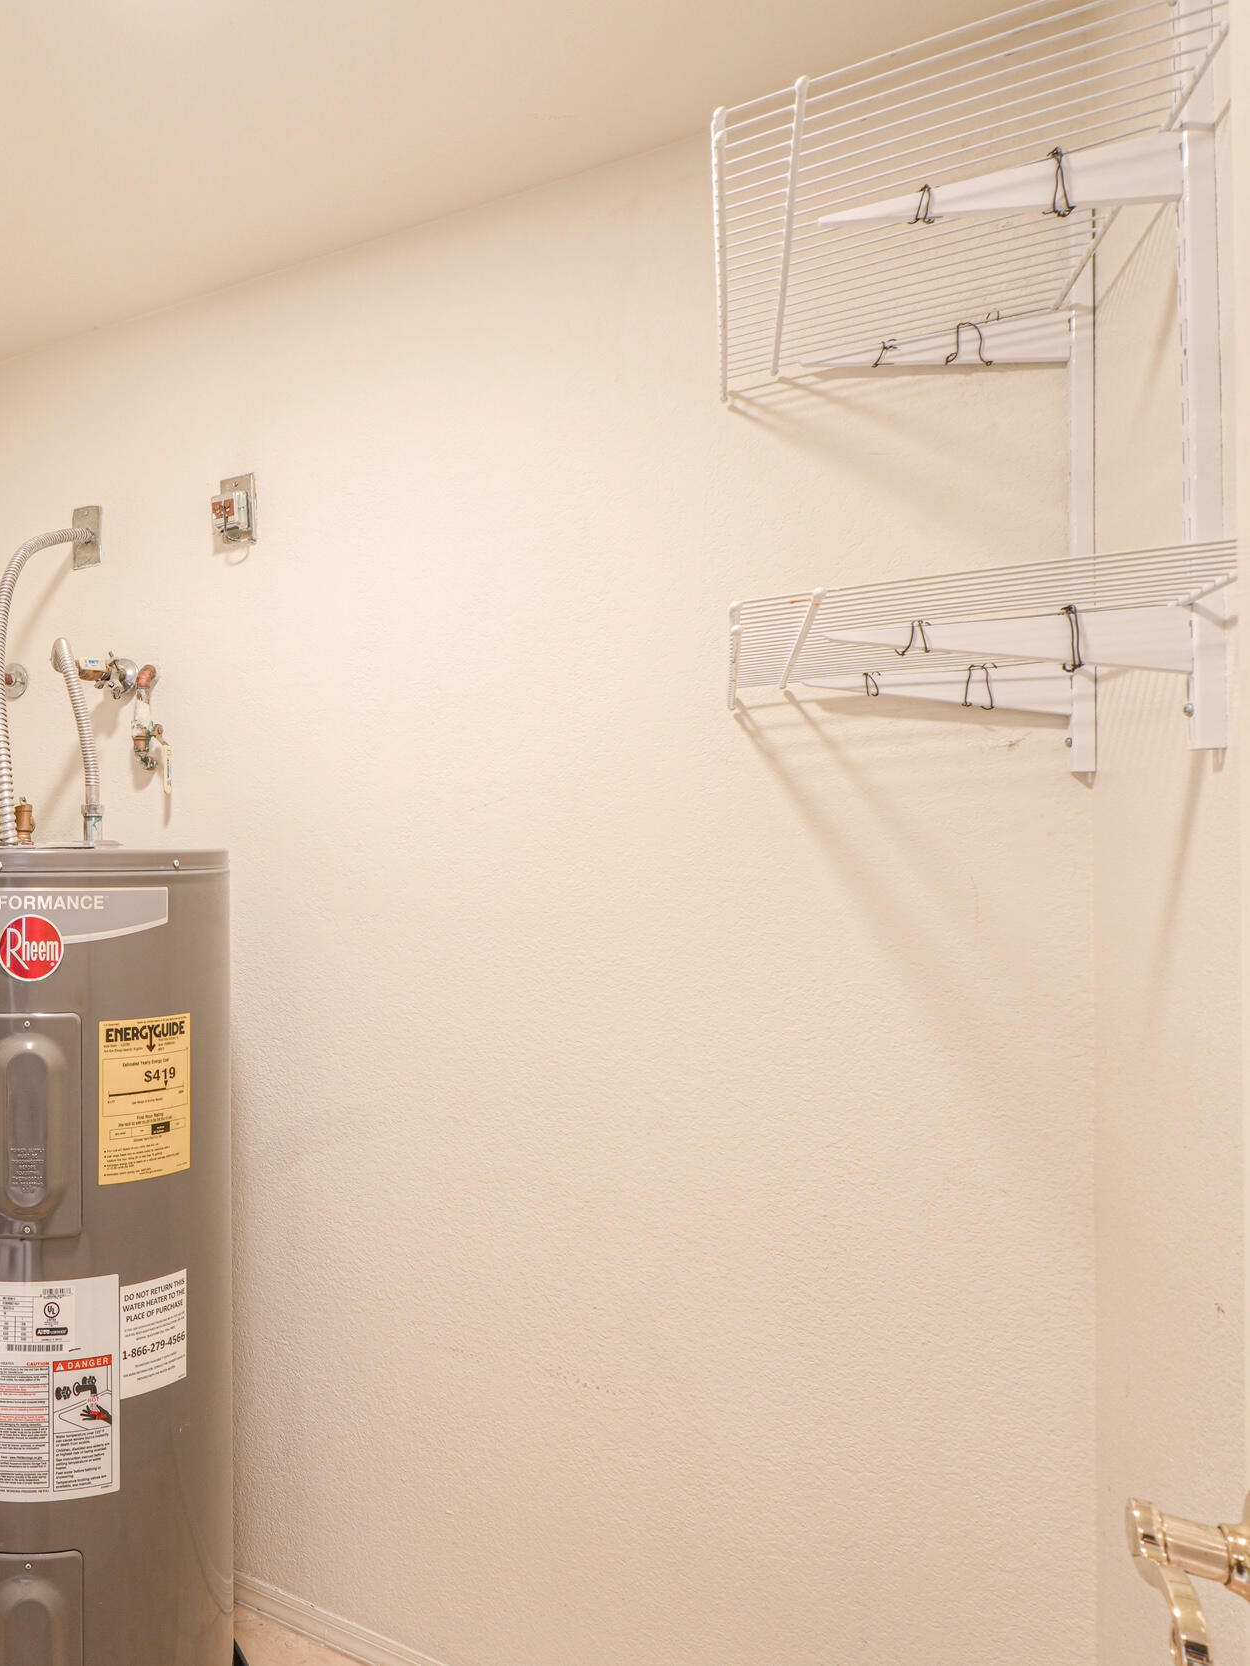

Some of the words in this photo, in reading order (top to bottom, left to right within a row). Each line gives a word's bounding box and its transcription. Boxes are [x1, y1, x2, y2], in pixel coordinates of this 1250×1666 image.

[6, 917, 59, 970] Rheem
[105, 1021, 185, 1043] ENERGYGUIDE
[144, 1067, 176, 1083] $419
[136, 1290, 149, 1299] NOT
[151, 1282, 172, 1296] RETURN
[174, 1278, 184, 1288] THIS
[47, 1306, 56, 1315] UL
[123, 1301, 145, 1312] WATER
[146, 1294, 167, 1306] HEATER
[176, 1288, 185, 1296] THE
[126, 1311, 144, 1322] PLACE
[147, 1309, 155, 1317] OF
[156, 1299, 183, 1315] PURCHASE
[123, 1331, 185, 1360] 1-866-279-4566
[67, 1357, 109, 1369] DANGER
